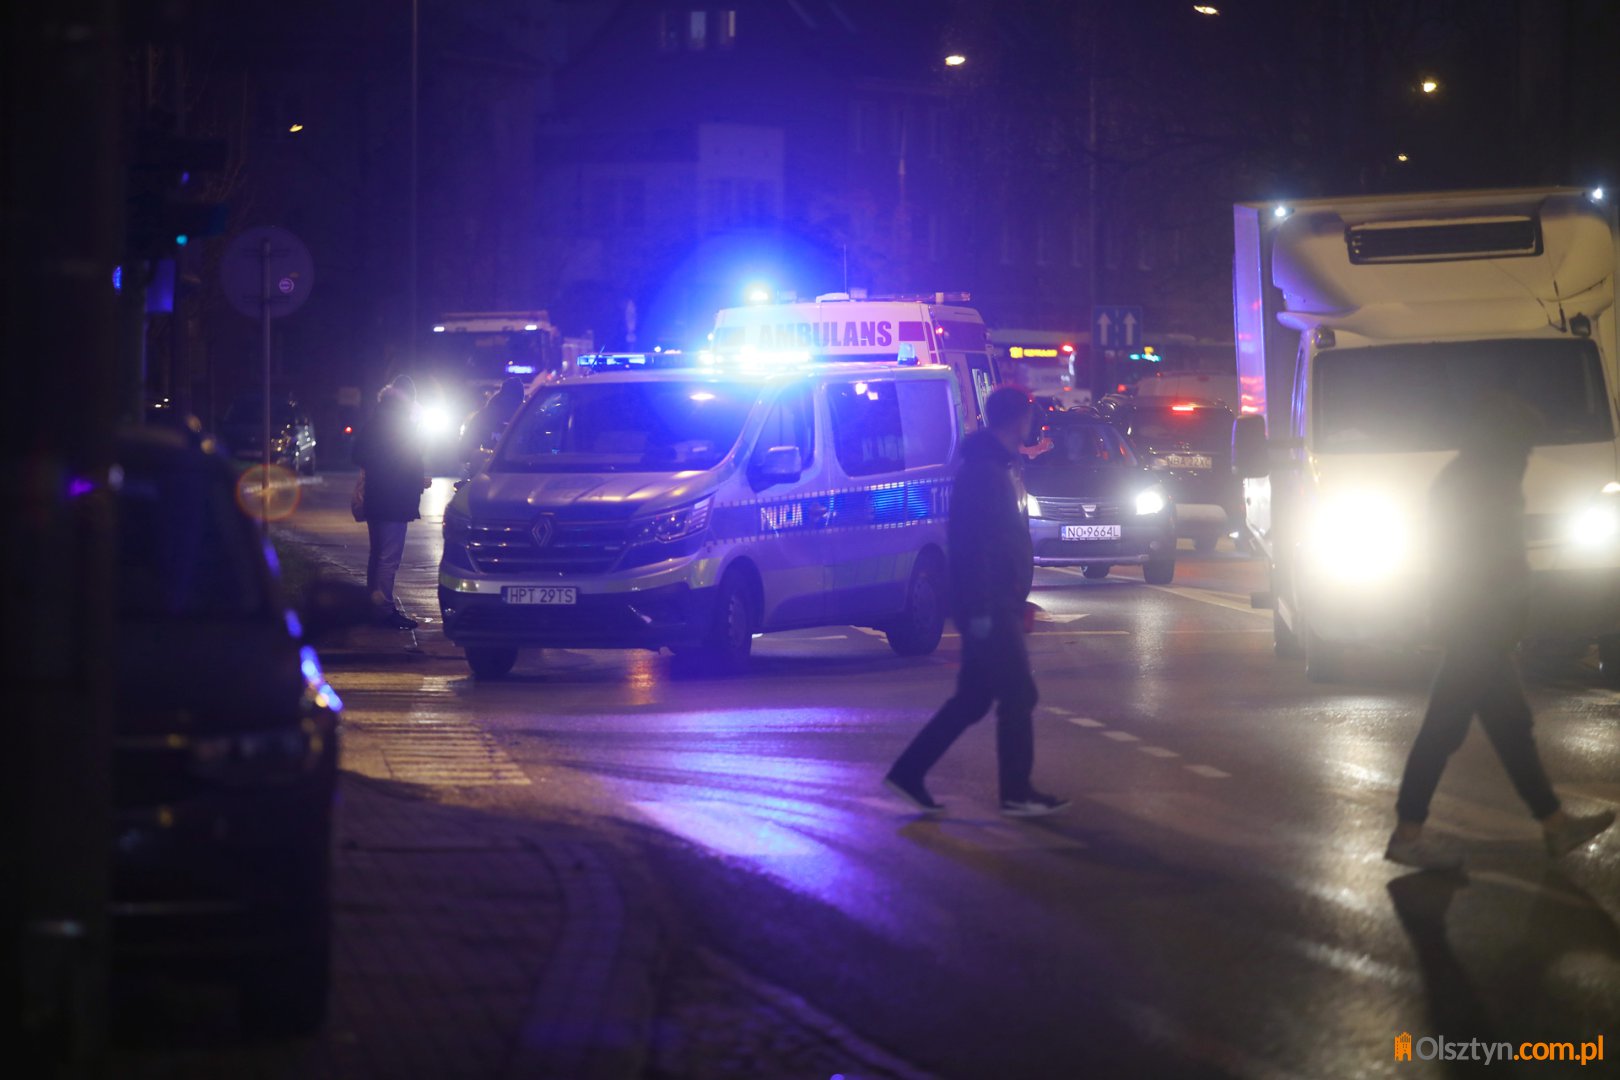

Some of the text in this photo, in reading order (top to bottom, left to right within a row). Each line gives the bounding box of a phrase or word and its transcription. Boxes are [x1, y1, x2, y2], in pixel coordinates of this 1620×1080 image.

[760, 321, 893, 347] AMBULANS
[510, 588, 573, 603] HPT 29TS
